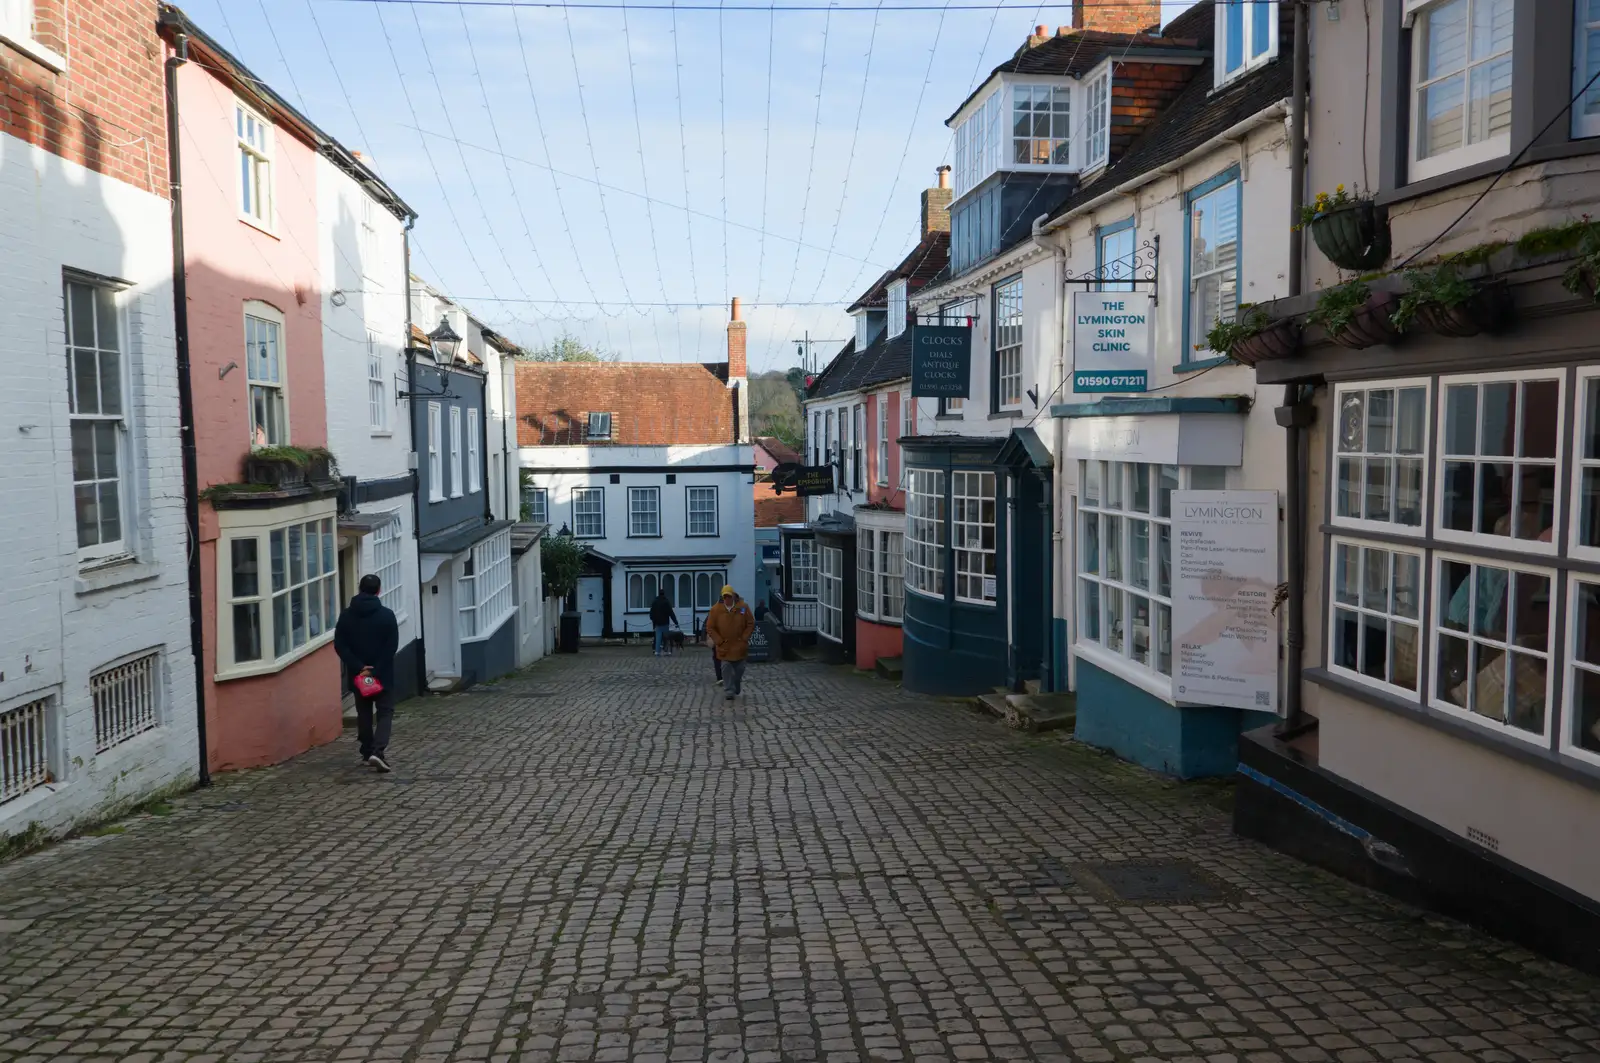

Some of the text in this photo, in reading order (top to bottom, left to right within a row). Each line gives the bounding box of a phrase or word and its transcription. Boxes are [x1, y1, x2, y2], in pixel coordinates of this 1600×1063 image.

[1102, 302, 1125, 311] THE
[1078, 315, 1145, 324] LYMINGTON
[1097, 329, 1125, 338] SKIN
[921, 336, 964, 346] CLOCKS
[1092, 343, 1131, 352] CLINIC
[921, 361, 960, 370] ANTIQUE
[924, 371, 957, 379] CLOCKS
[1077, 376, 1145, 386] 01590 671211
[1184, 507, 1263, 519] LYMINGTON
